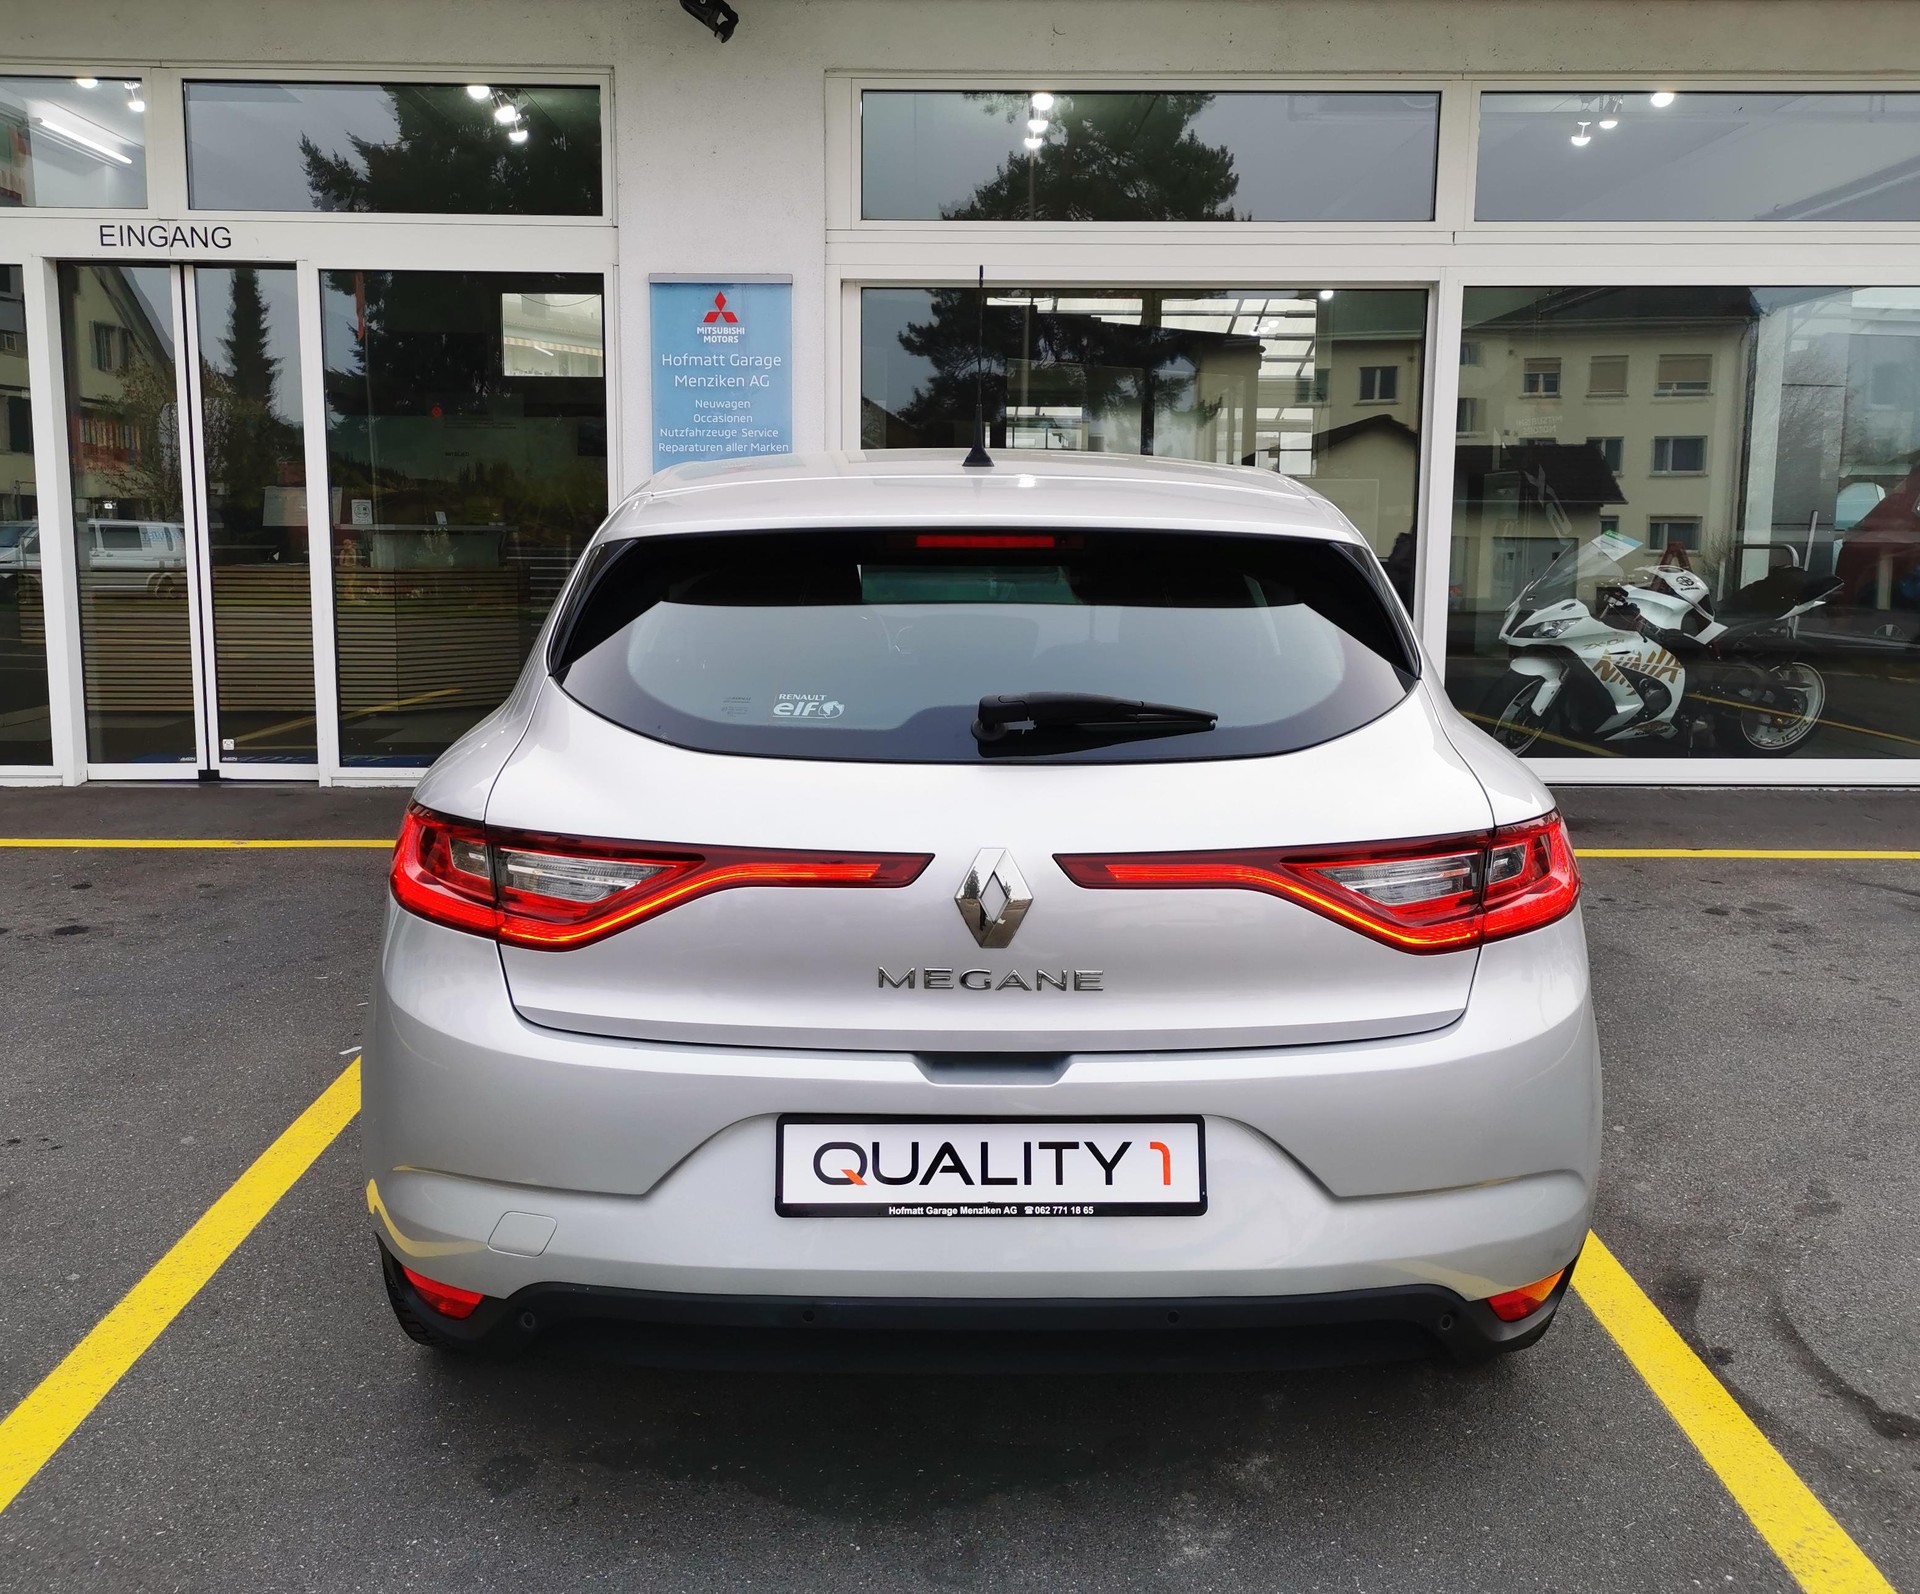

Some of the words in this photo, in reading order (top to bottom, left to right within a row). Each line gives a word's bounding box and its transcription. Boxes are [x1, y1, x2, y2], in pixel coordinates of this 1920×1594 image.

[99, 224, 232, 250] EINGANG
[696, 326, 745, 335] MITSUBISHI
[703, 335, 739, 344] MOTORS
[661, 353, 726, 367] Hofmatt
[729, 353, 782, 370] Garage
[674, 374, 745, 388] Menziken
[749, 374, 770, 388] AG
[695, 399, 751, 411] Neuwagen
[693, 413, 753, 424] Occasionen
[660, 427, 737, 439] Nutzfahrzeuge
[741, 428, 779, 438] Service
[658, 442, 723, 454] Reparaturen
[725, 442, 748, 453] aller
[750, 442, 789, 452] Marken
[778, 693, 827, 701] RENAULT
[772, 701, 819, 717] elf
[877, 965, 1104, 992] MEGANE
[812, 1140, 1133, 1186] QUALITY
[1149, 1141, 1171, 1186] 1
[888, 1205, 924, 1215] Hofmatt
[925, 1206, 958, 1216] Garage
[959, 1205, 1002, 1215] Menziken
[1003, 1206, 1018, 1215] AG
[1034, 1206, 1051, 1215] 062
[1052, 1206, 1068, 1215] 771
[1070, 1206, 1081, 1215] 18
[1083, 1206, 1094, 1215] 65
